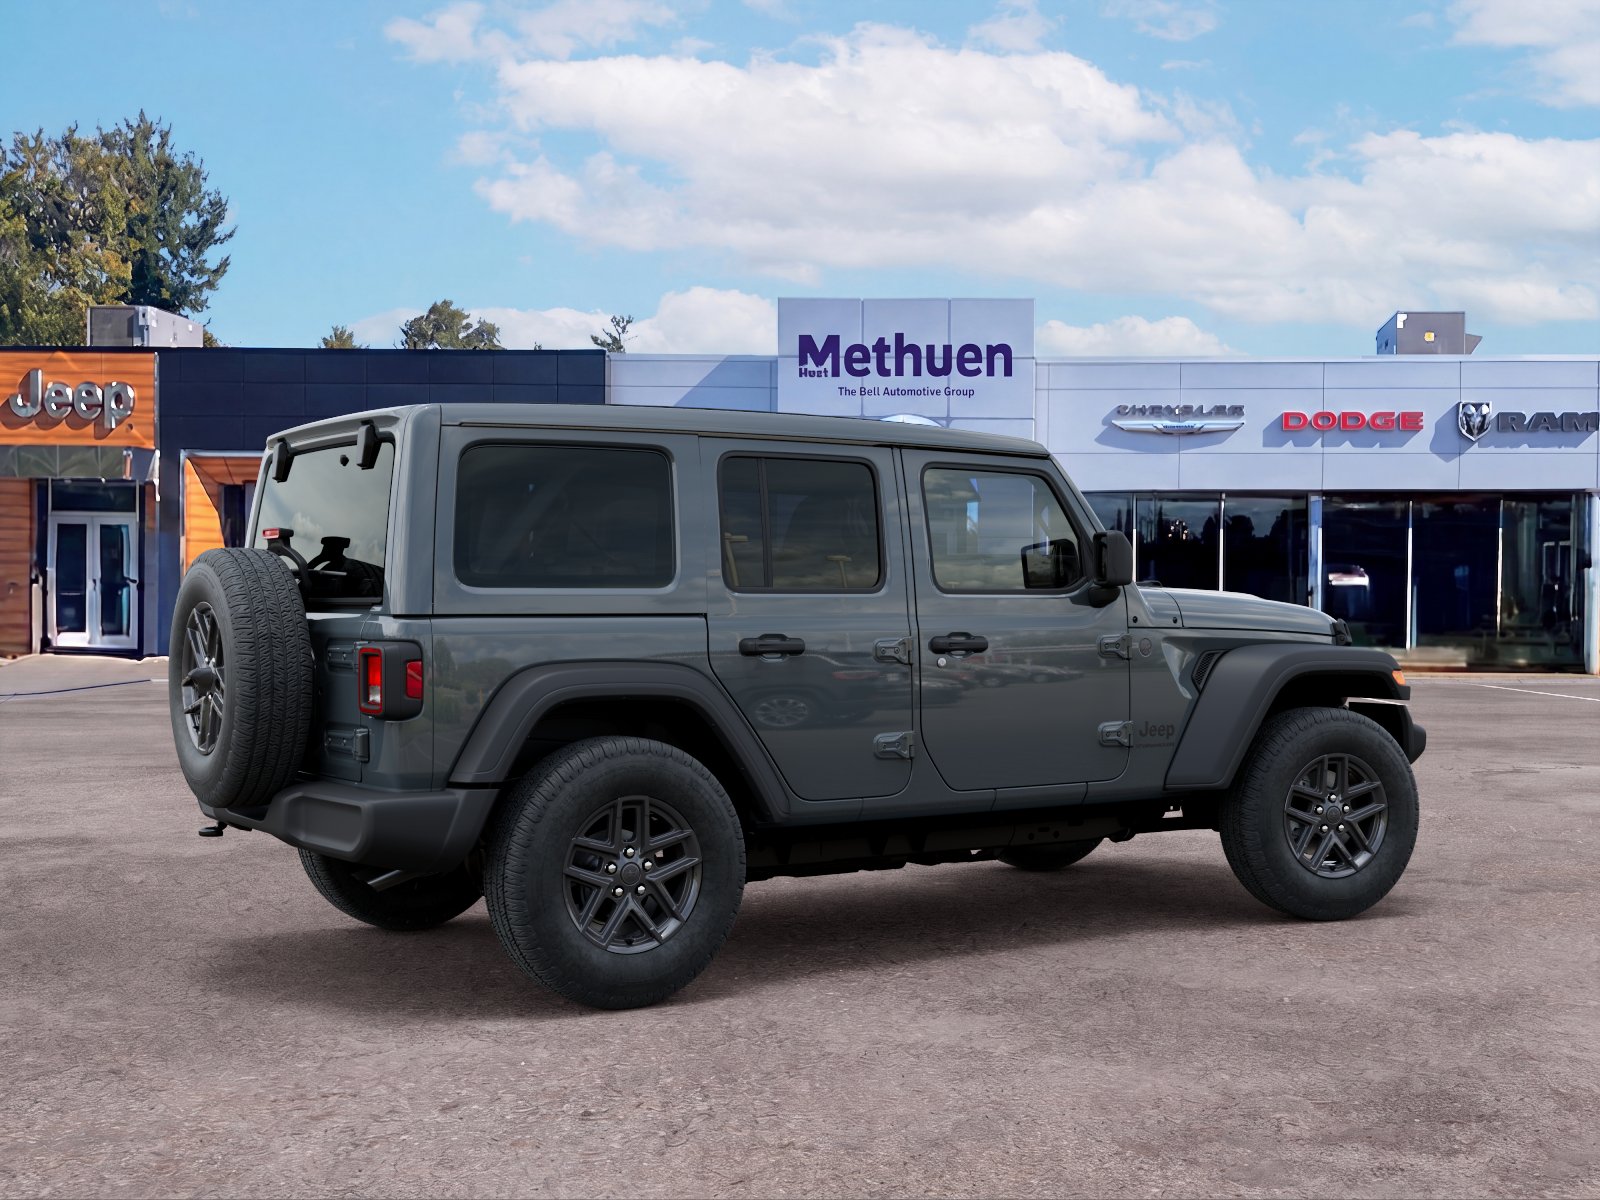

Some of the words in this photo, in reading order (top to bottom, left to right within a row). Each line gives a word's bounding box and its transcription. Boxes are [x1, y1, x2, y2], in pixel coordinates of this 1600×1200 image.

[798, 333, 1013, 378] Methuen
[9, 368, 136, 429] Jeep
[838, 386, 857, 396] The
[860, 386, 880, 396] Bell
[883, 386, 941, 396] Automotive
[944, 386, 975, 398] Group
[1282, 411, 1424, 431] DODGE
[1498, 411, 1599, 432] RAM
[1138, 721, 1175, 739] Jeep
